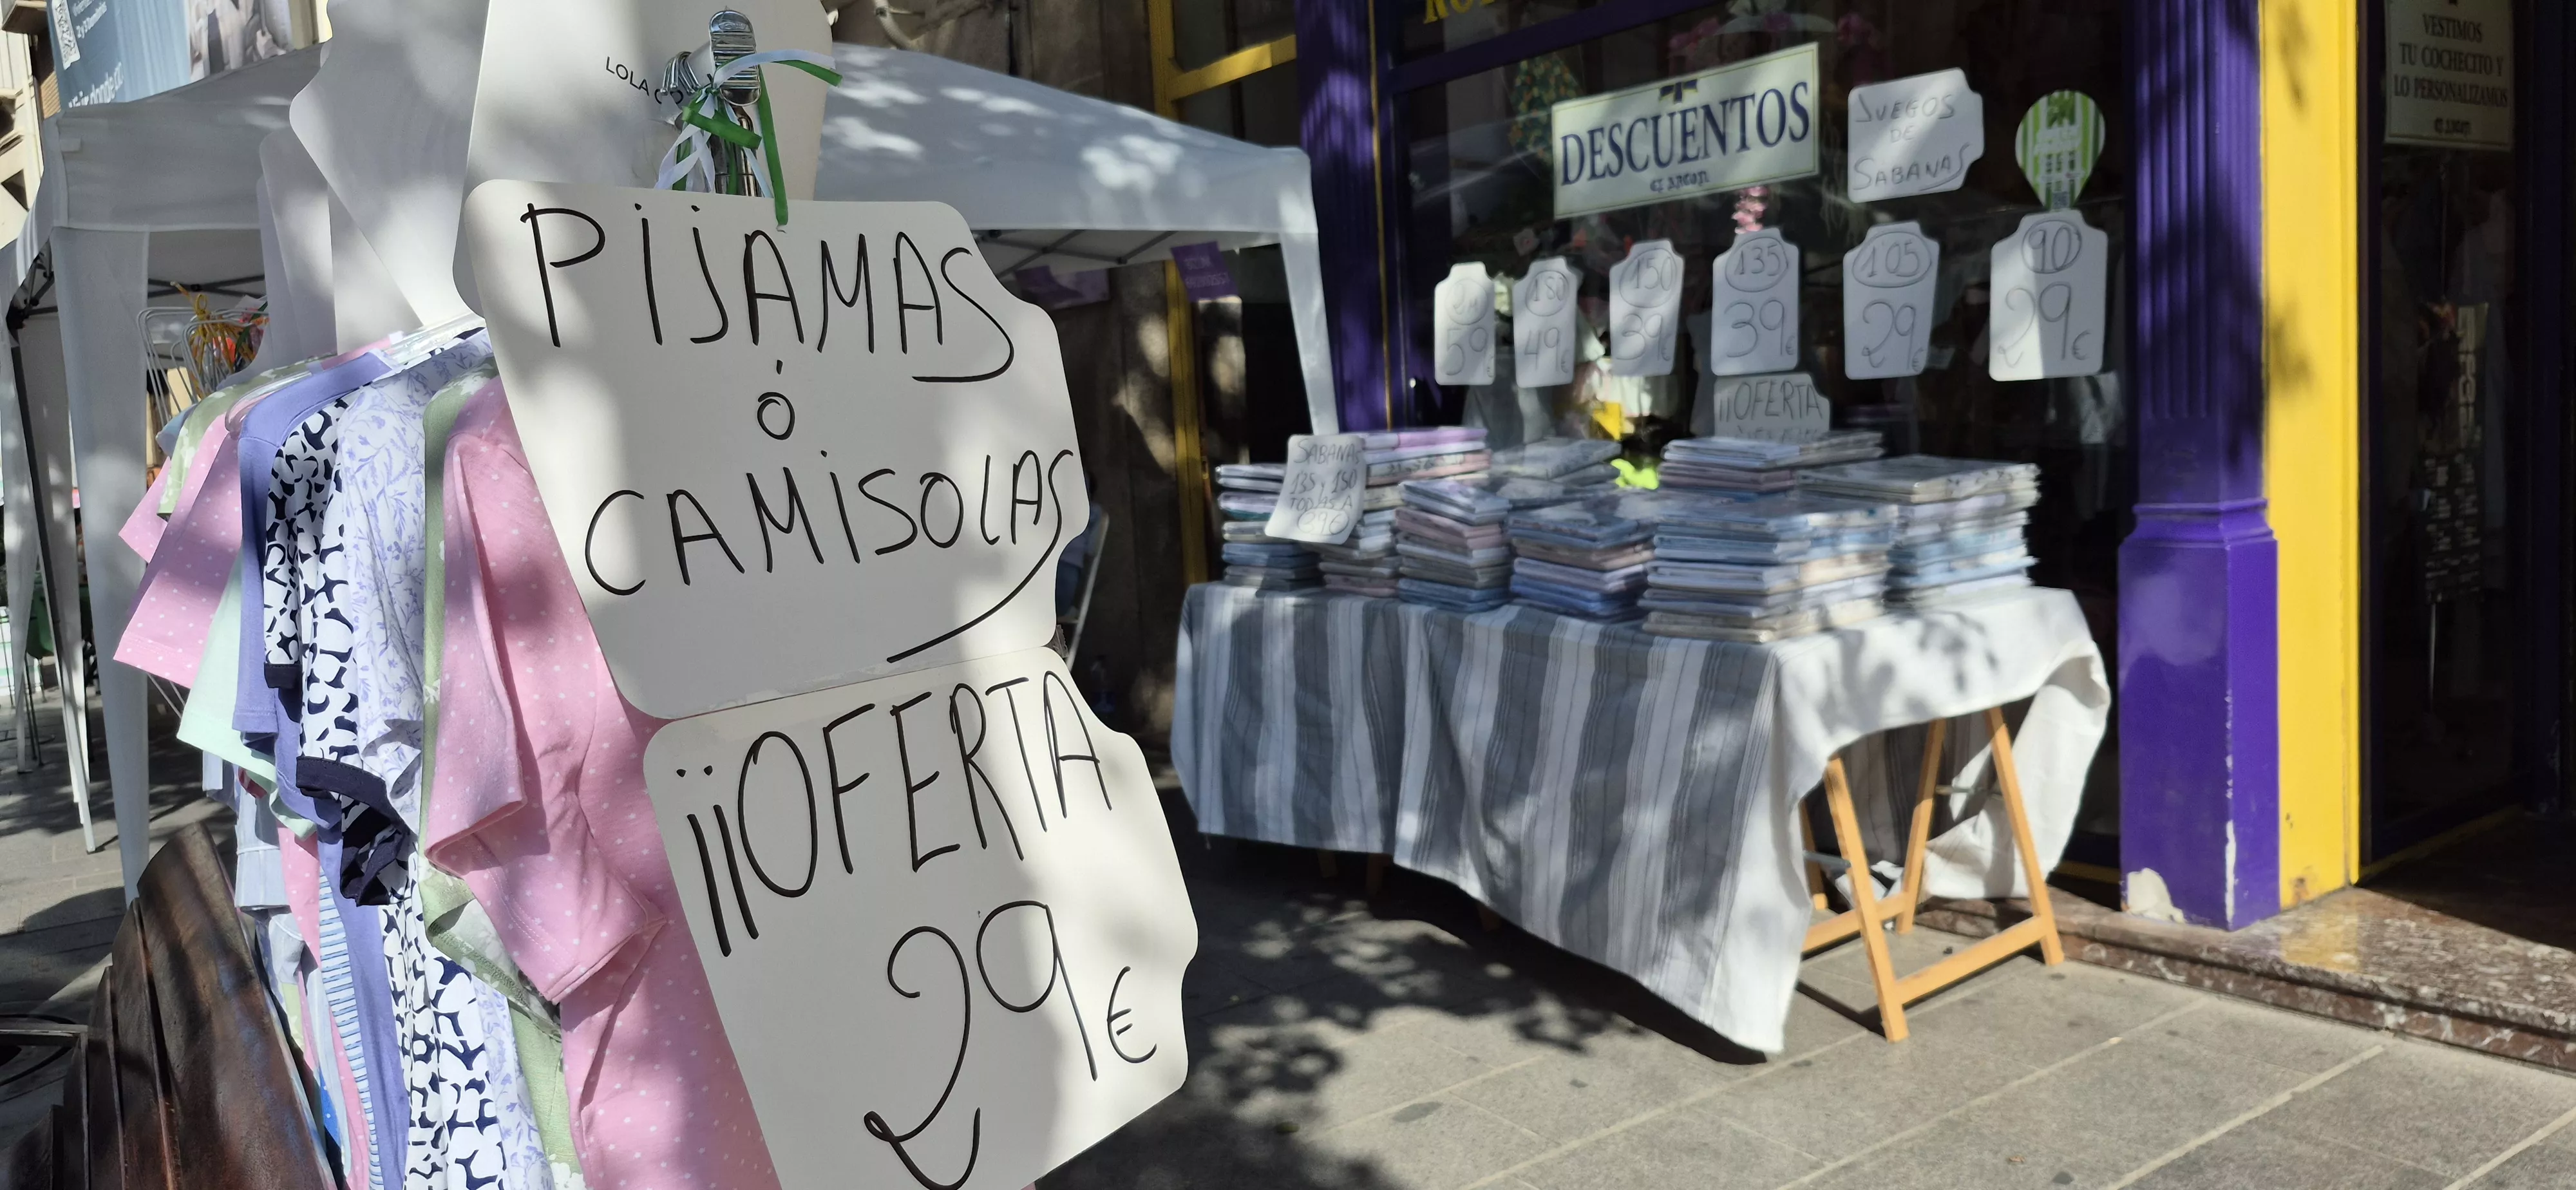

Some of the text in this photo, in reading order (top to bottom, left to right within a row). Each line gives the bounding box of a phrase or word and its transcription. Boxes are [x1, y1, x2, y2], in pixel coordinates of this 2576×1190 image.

[2422, 14, 2483, 43] VESTIMOS
[605, 57, 650, 97] LOLA
[2398, 42, 2504, 77] TU COCHECITO Y
[1855, 94, 1955, 122] JUEGOS
[2394, 74, 2508, 108] LO PERSONALIZAMOS
[1560, 82, 1810, 186] DESCUENTOS
[1890, 125, 1915, 143] DE
[1853, 142, 1971, 191] SABANAS
[1734, 244, 1781, 276] 135
[1861, 240, 1920, 278] 105
[2029, 225, 2072, 272] 90
[520, 203, 1015, 382] PIJAMAS
[1533, 276, 1567, 302] 180
[1629, 256, 1674, 291] 150
[1616, 314, 1672, 362] 39€
[1724, 299, 1795, 358] 39€
[1862, 299, 1925, 372] 29€
[1998, 281, 2092, 368] 29€
[1524, 327, 1569, 373] 49€
[1293, 438, 1359, 464] SABANAS
[1289, 470, 1316, 495] 135
[1331, 469, 1358, 493] 150
[1290, 495, 1353, 512] TODAS A
[584, 449, 1074, 663] CAMISOLAS
[864, 900, 1158, 1190] 29€
